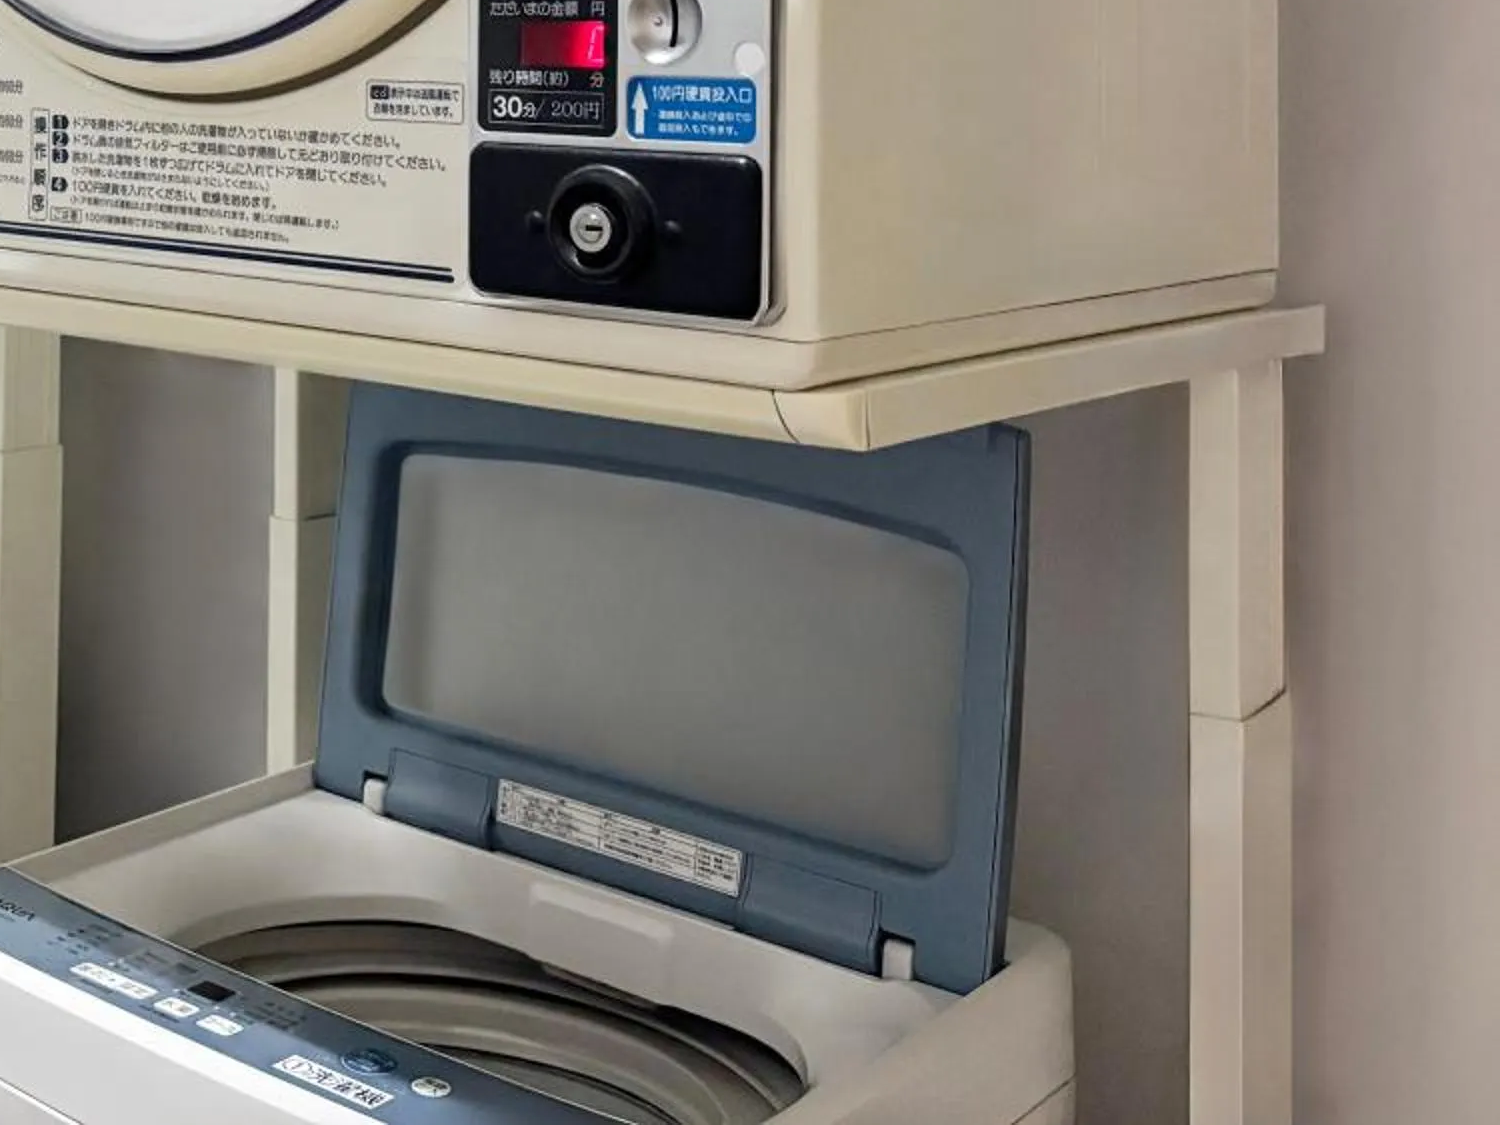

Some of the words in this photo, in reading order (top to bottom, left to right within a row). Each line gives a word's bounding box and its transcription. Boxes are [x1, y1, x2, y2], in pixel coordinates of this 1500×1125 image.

[591, 0, 605, 17] 円
[652, 84, 754, 105] 100円硬貨投入口
